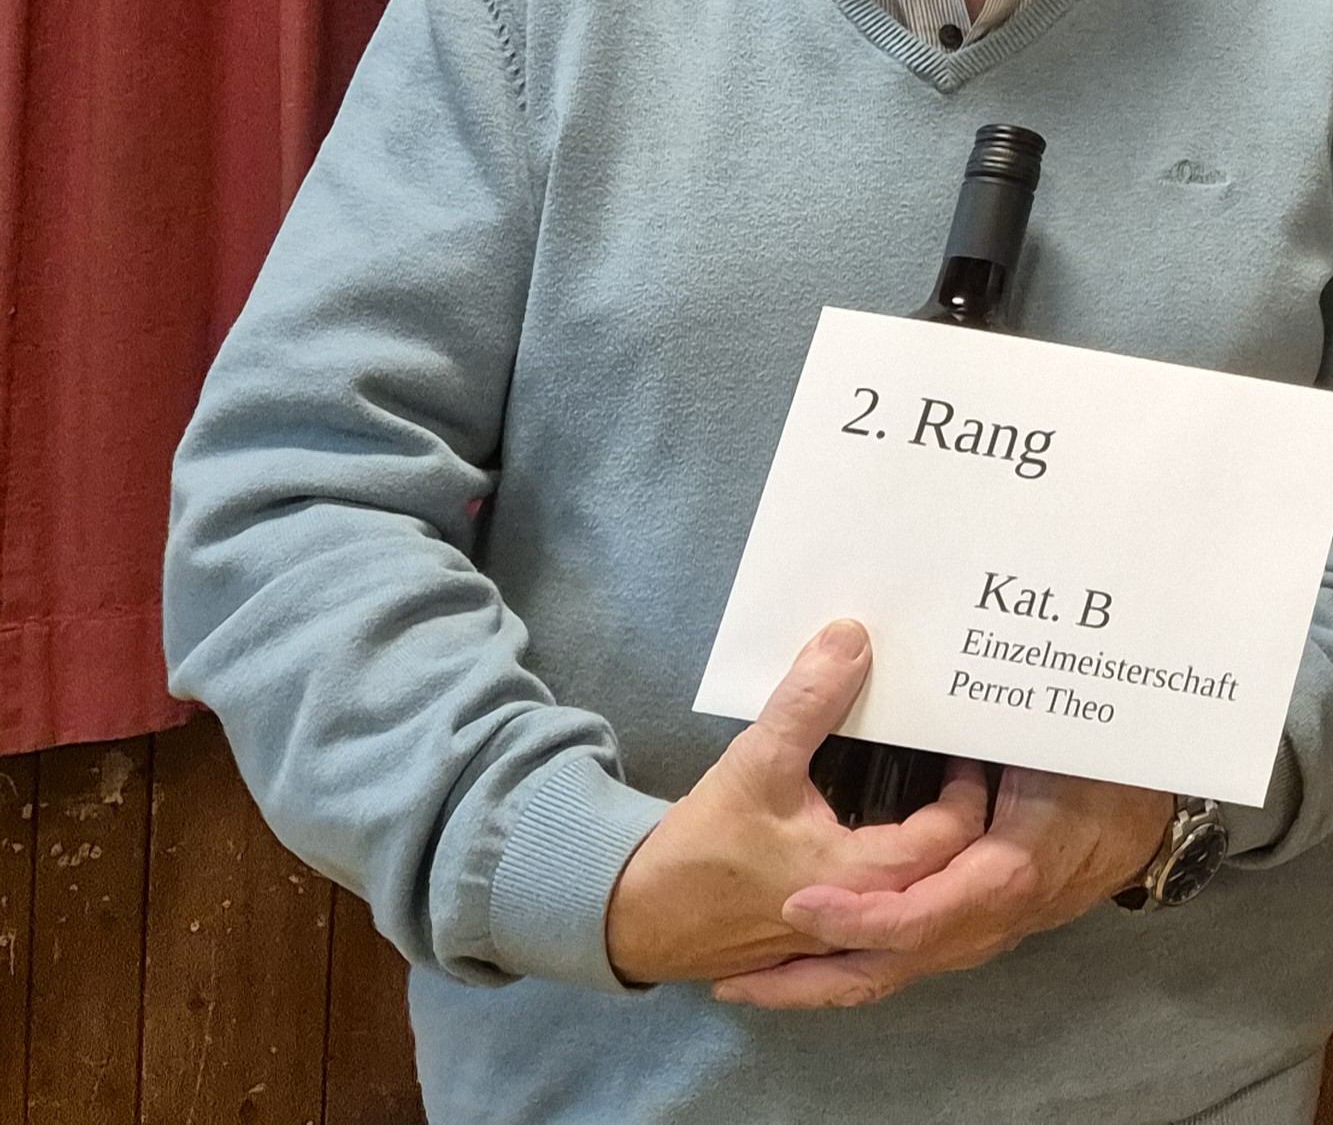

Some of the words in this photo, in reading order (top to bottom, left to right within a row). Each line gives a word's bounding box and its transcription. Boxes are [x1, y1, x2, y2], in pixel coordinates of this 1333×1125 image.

[841, 387, 886, 440] 2.
[907, 397, 1057, 480] Rang
[974, 571, 1059, 622] Kat.
[1075, 589, 1113, 629] B
[948, 670, 1036, 711] Perrot
[1045, 686, 1115, 724] Theo
[960, 628, 1239, 702] Einzelmeisterschaft
